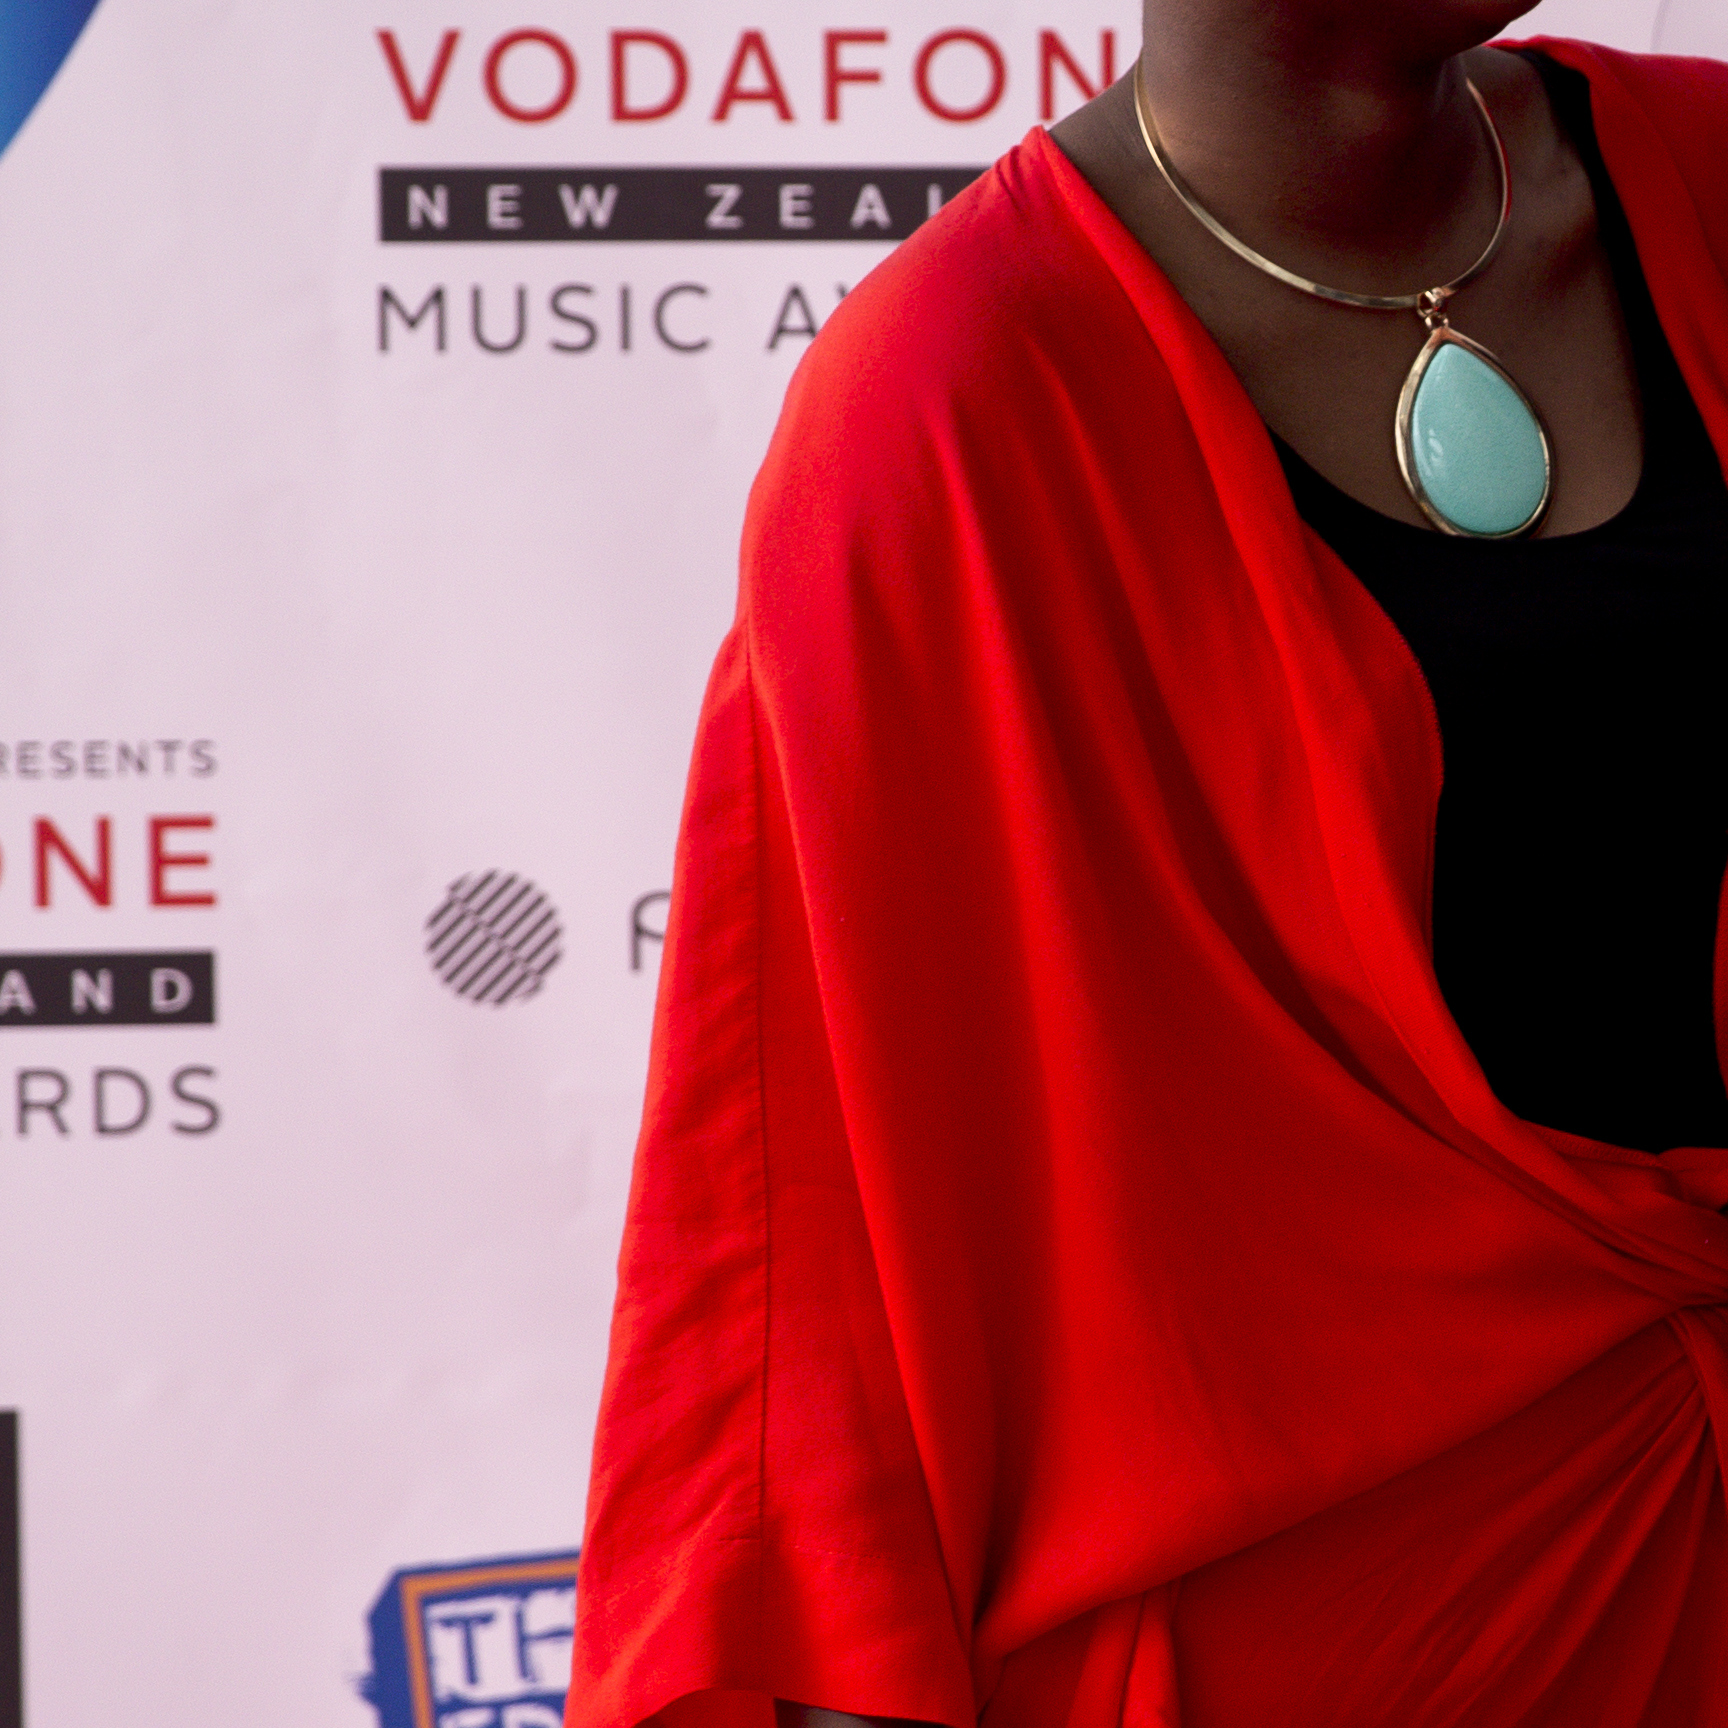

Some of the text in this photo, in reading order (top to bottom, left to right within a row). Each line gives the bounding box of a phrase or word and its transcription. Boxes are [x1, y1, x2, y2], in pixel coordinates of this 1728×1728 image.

[376, 25, 1117, 124] VODAFON
[407, 184, 618, 229] NEW
[377, 281, 848, 357] MUSIC A
[15, 1064, 222, 1138] RDS
